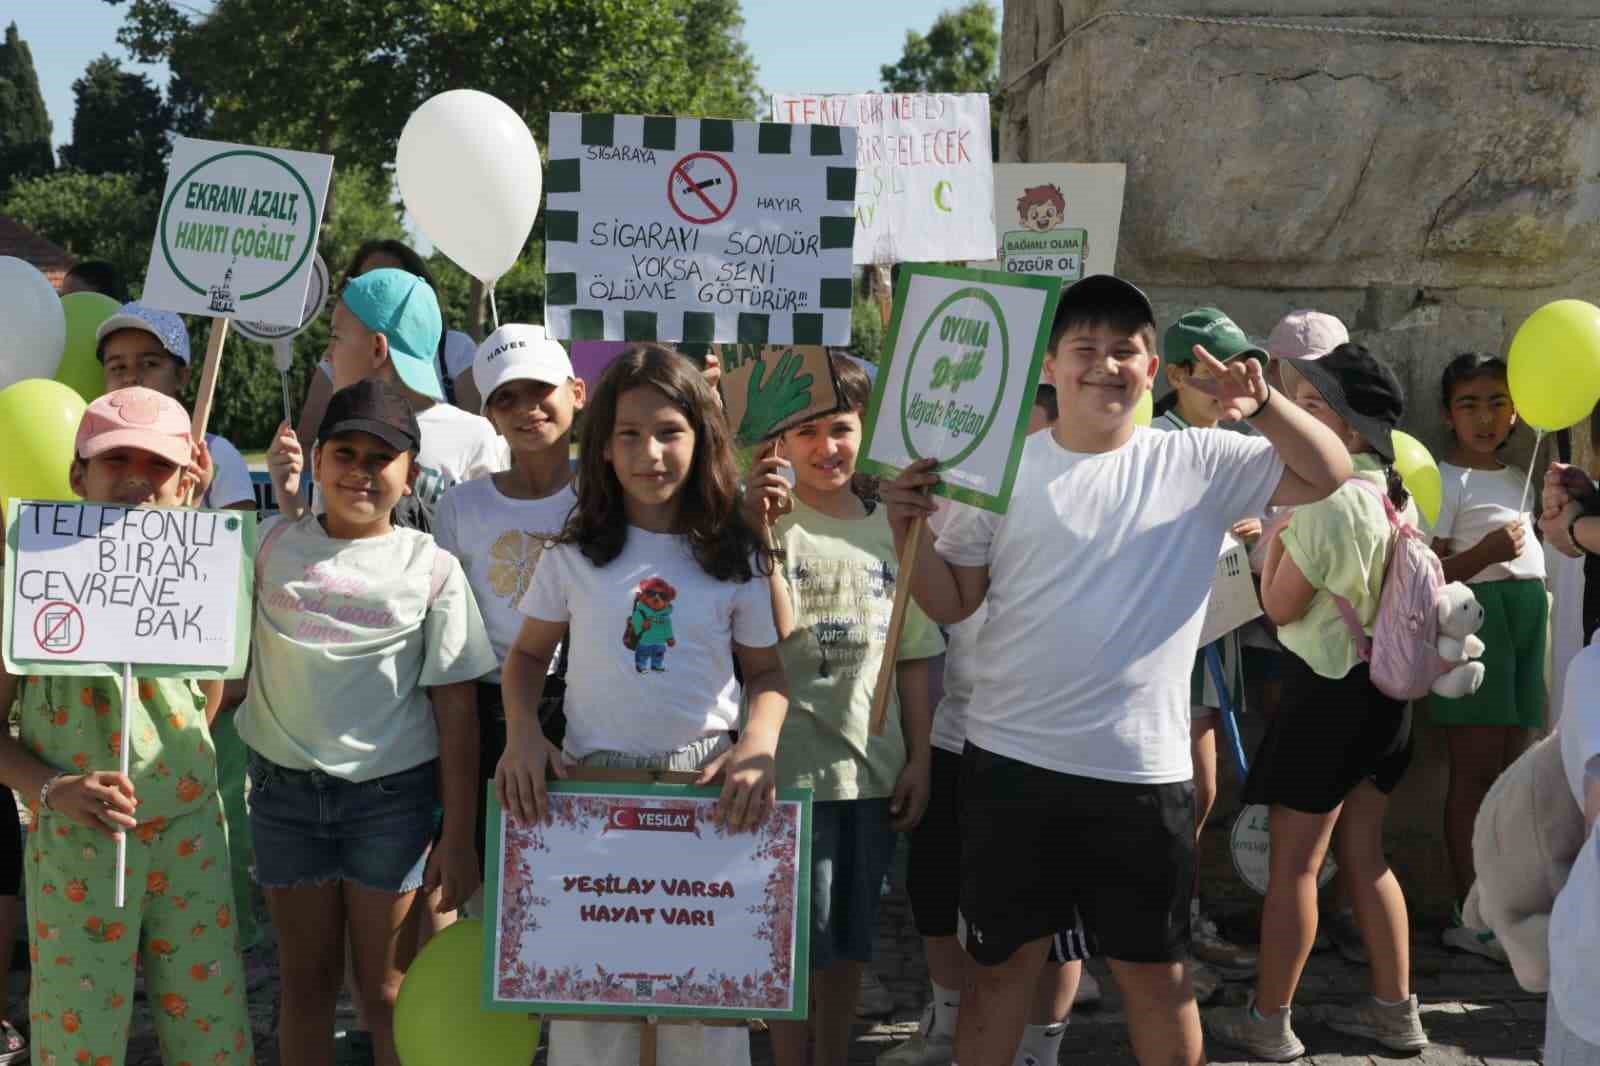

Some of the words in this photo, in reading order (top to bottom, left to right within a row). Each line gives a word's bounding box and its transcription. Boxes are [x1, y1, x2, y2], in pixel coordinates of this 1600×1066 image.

[185, 182, 247, 215] EKRANI
[248, 189, 299, 226] AZALT,
[757, 197, 802, 213] HAYIR
[174, 220, 230, 253] HAYATI
[232, 224, 297, 262] ÇOĞALT
[590, 218, 699, 251] SİGARAYI
[1050, 240, 1079, 249] OLMA
[632, 254, 703, 281] YOKSA
[716, 259, 775, 284] SENİ
[1007, 256, 1053, 272] ÖZGÜR
[1058, 258, 1076, 270] OL
[589, 275, 676, 301] ÖLÜME
[940, 315, 990, 348] OYUNA
[20, 503, 216, 547] TELEFONU
[99, 540, 207, 583] BIRAK,
[19, 570, 180, 609] ÇEVRENE
[563, 873, 655, 897] YEŞİLAY
[661, 879, 735, 898] VARSA
[580, 905, 655, 925] HAYAT
[660, 908, 715, 926] VAR!
